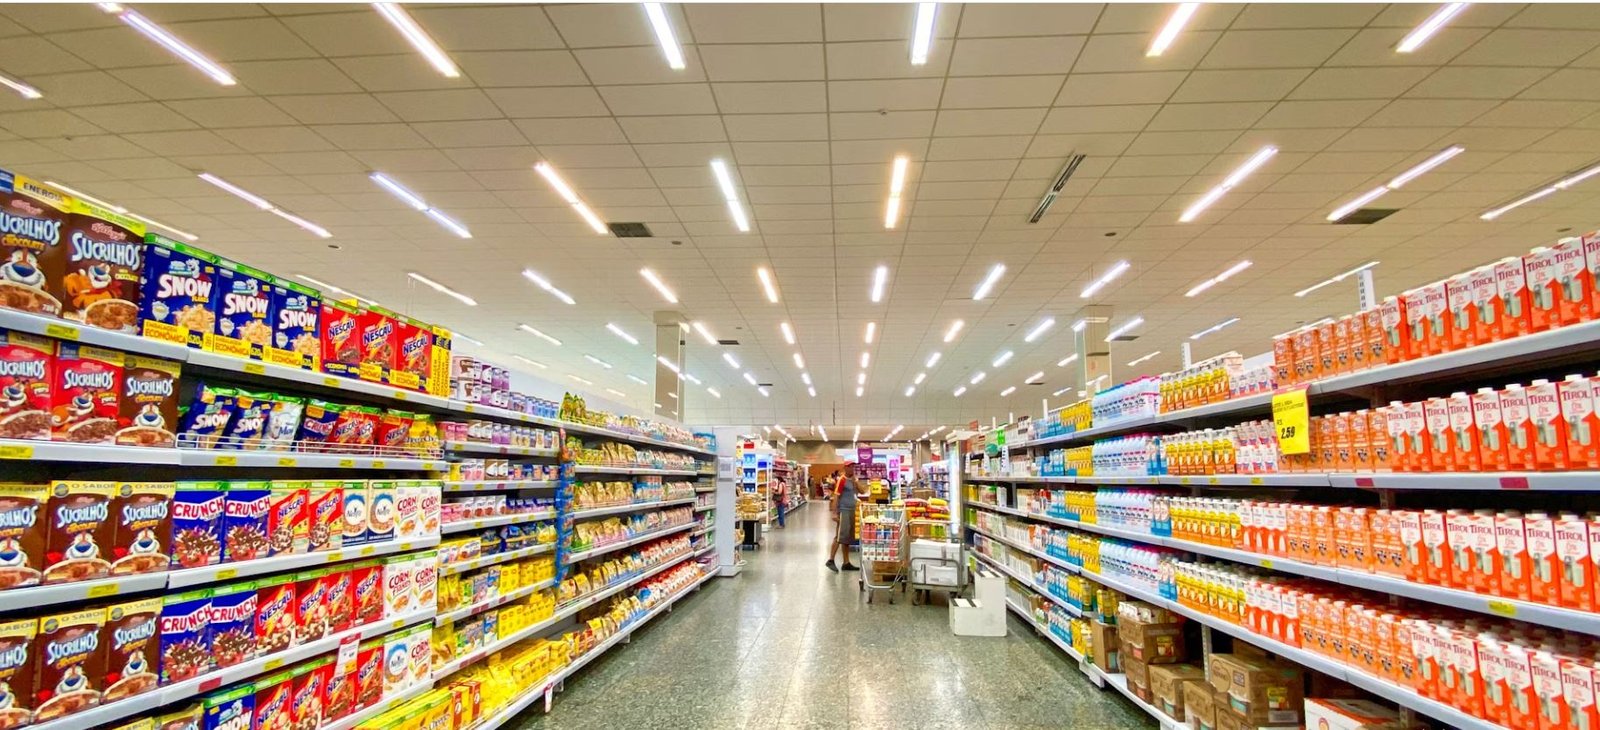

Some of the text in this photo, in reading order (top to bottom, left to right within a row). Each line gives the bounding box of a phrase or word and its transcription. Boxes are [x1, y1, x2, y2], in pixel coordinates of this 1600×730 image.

[0, 212, 61, 246] UCRILHOS
[71, 232, 141, 271] SUCRILHOS
[1586, 240, 1600, 253] TIR
[1554, 248, 1582, 264] TIROL
[1498, 268, 1522, 281] TIROL
[1527, 259, 1553, 273] TIROL
[157, 274, 212, 298] SNOW
[1472, 276, 1495, 289] TIROL
[223, 293, 268, 315] SNOW
[279, 309, 317, 329] SNOW
[328, 318, 355, 338] NESCAU
[363, 323, 392, 344] NESCAU
[403, 335, 428, 354] NESCAU
[0, 359, 45, 379] UCRILHOS
[64, 369, 114, 389] SUCRILHOS
[126, 377, 173, 397] SUCRILHOS
[1502, 399, 1526, 408] TIROL
[1529, 394, 1556, 405] TIROL
[1562, 390, 1590, 402] TIROL
[1475, 402, 1499, 411] TIROL
[191, 412, 231, 430] SNOW
[173, 497, 224, 517] CRUNCH
[226, 497, 271, 516] CRUNCH
[397, 496, 417, 512] CORN
[421, 496, 439, 510] CORN
[0, 505, 38, 528] RILHOS
[57, 501, 109, 528] SUCRILHOS
[122, 501, 169, 526] SUCRILHOS
[1423, 521, 1441, 530] TIROL
[1448, 523, 1469, 532] TIROL
[1469, 525, 1493, 535] TIROL
[1497, 526, 1522, 537] TIROL
[1527, 528, 1552, 539] TIROL
[1556, 530, 1586, 542] TIROL
[389, 570, 409, 589] CORN
[415, 566, 434, 583] CORN
[259, 589, 292, 624] NESCAU
[300, 583, 326, 614] NESCAU
[72, 611, 106, 620] SABOR
[211, 597, 258, 621] CRUNCH
[162, 605, 212, 632] CRUNCH
[114, 617, 157, 650] SUCRILHOS
[47, 629, 99, 665] SUCRILHOS
[411, 640, 429, 659] CORN
[1453, 644, 1473, 657] TIROL
[1479, 651, 1500, 664] TIROL
[1503, 658, 1527, 672] TIROL
[1532, 665, 1557, 680] TIROL
[1562, 673, 1590, 688] TIROL
[213, 710, 253, 730] NOW
